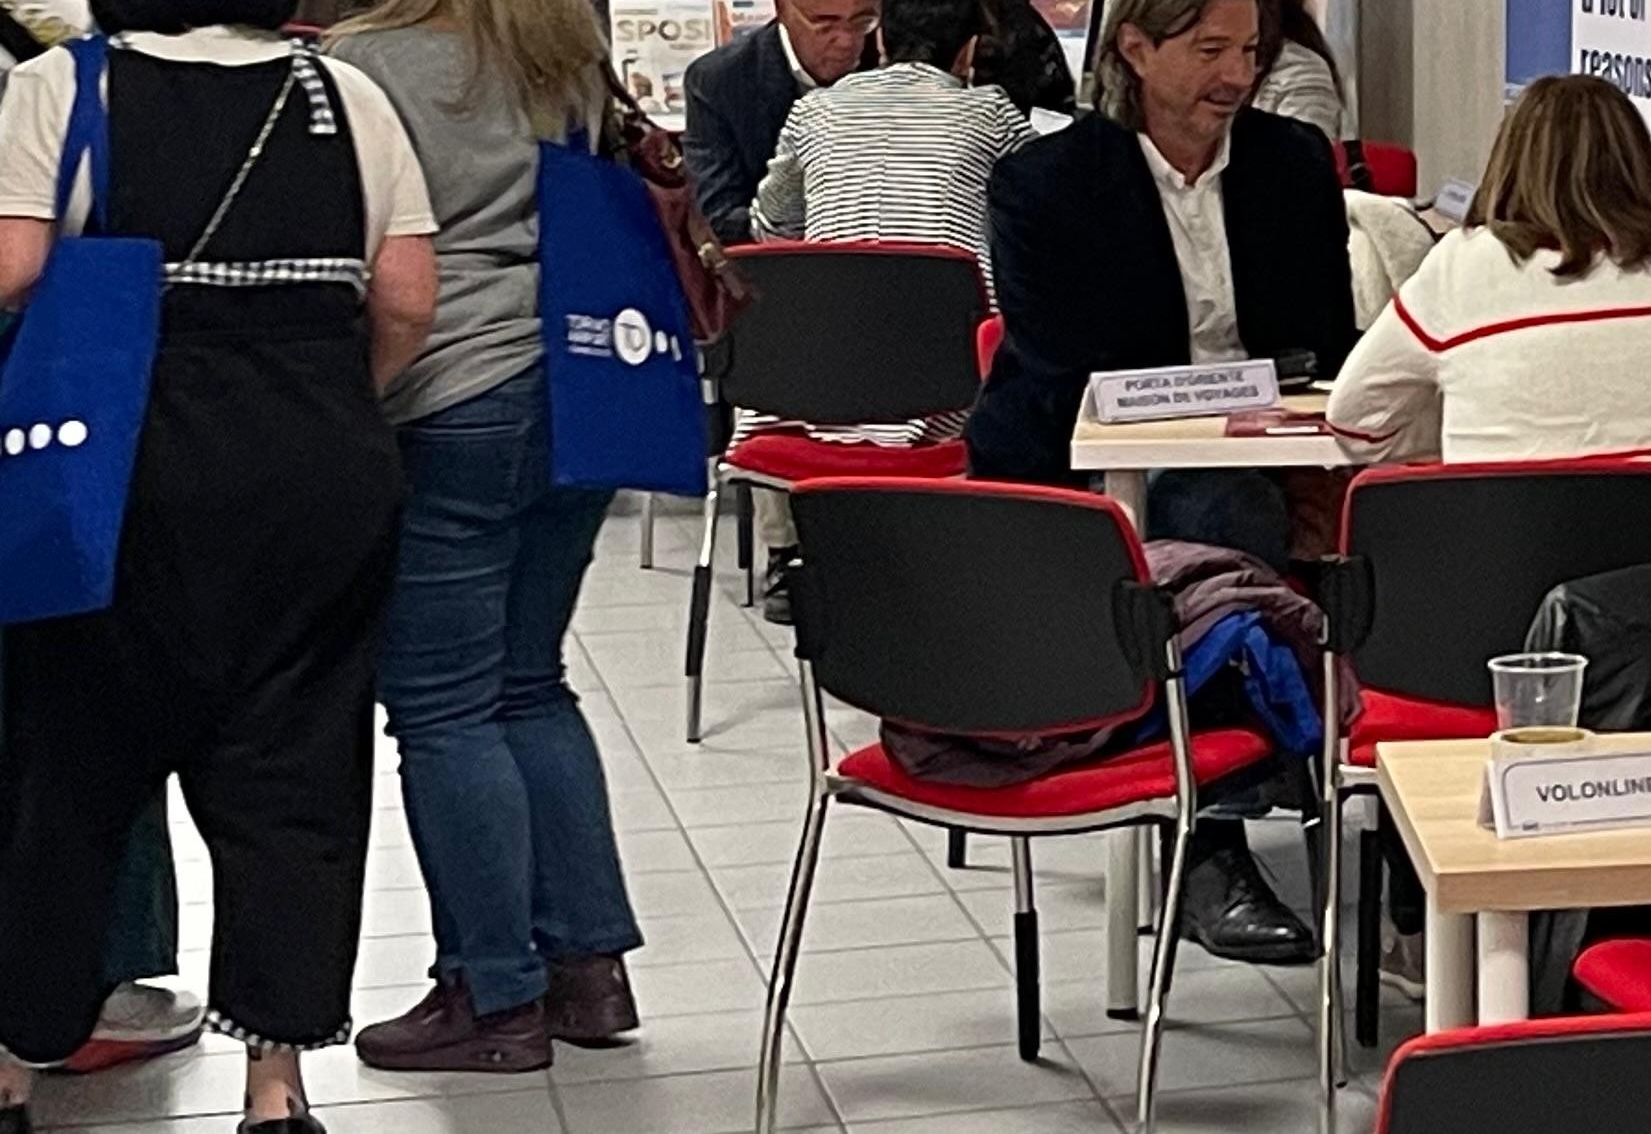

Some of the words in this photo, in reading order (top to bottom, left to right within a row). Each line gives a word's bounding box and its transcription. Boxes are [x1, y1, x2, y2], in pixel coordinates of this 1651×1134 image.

[615, 18, 711, 43] SPOSI
[1116, 393, 1171, 408] MAISON
[1193, 384, 1260, 402] VOYAGES
[1125, 377, 1171, 392] PORTA
